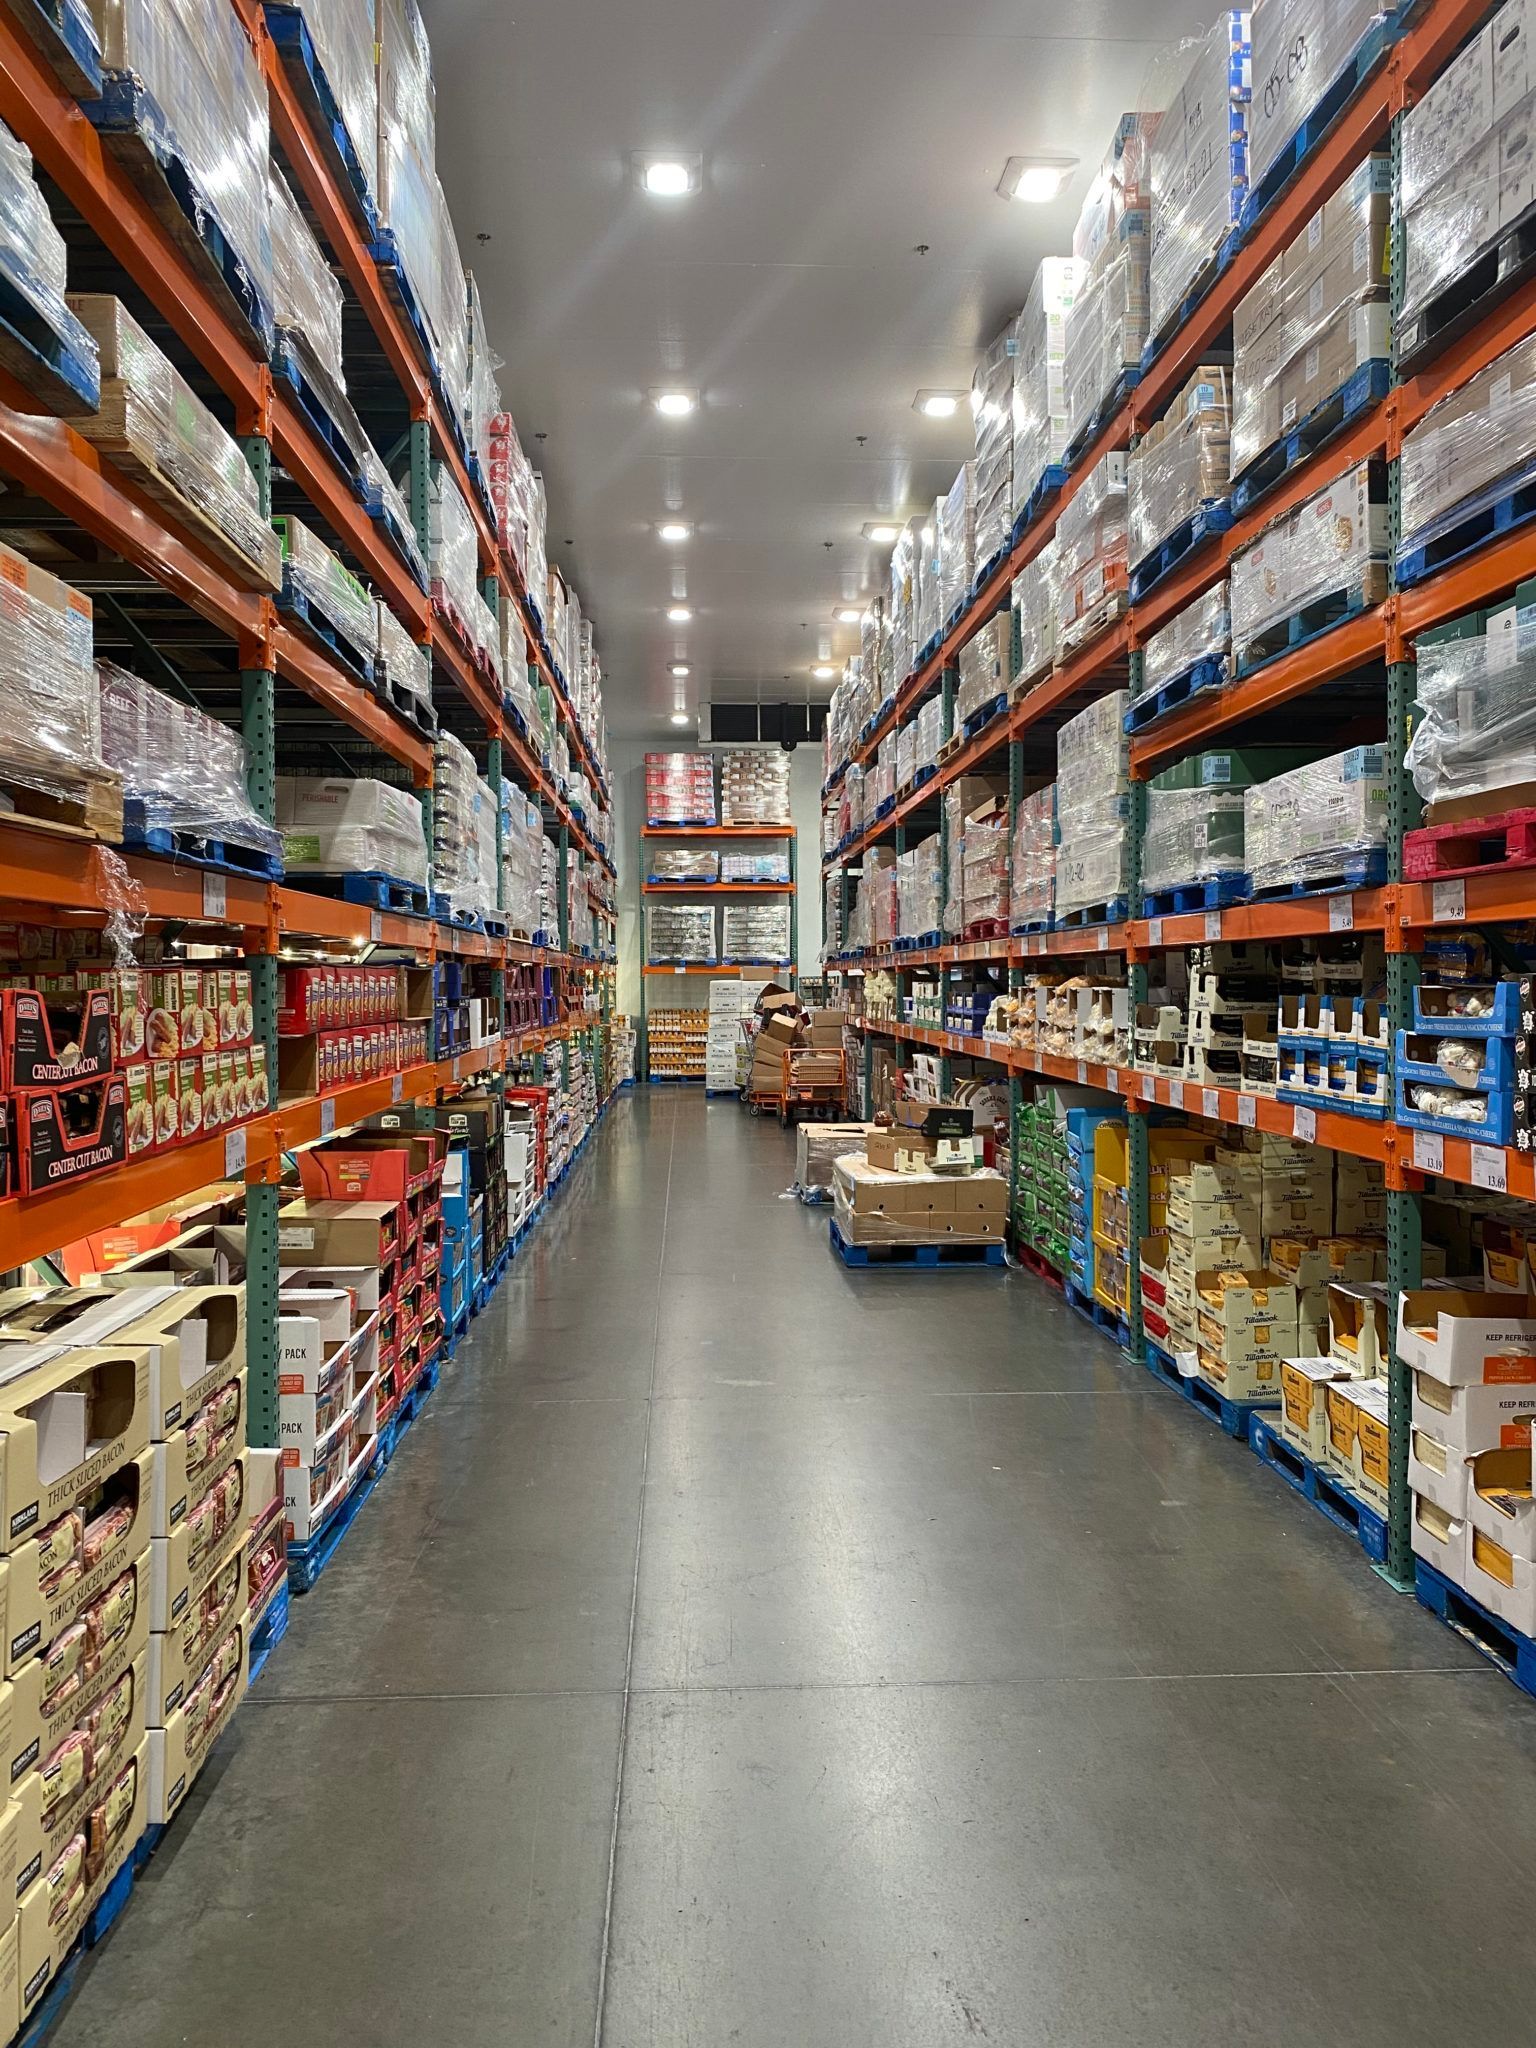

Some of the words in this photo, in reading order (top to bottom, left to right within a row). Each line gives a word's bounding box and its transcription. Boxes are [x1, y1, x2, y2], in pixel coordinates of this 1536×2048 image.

[1366, 748, 1376, 756] 113
[1450, 906, 1464, 918] 9.49
[32, 1064, 60, 1080] CENTER
[48, 1157, 76, 1178] CENTER
[76, 1153, 91, 1171] CUT
[91, 1145, 113, 1167] BACON
[1283, 1157, 1316, 1165] Tillamook
[1427, 1157, 1442, 1170] 13.19
[1487, 1175, 1505, 1190] 13.69
[1213, 1194, 1244, 1202] Tillamook
[1282, 1193, 1315, 1201] Tillamook
[1210, 1228, 1243, 1236] Tillamook
[1212, 1263, 1245, 1271] Tillamook
[1244, 1314, 1278, 1324] Tillamook
[285, 1348, 307, 1359] PACK
[1245, 1352, 1279, 1361] Tillamook
[1247, 1389, 1282, 1397] Tillamook
[281, 1423, 303, 1434] PACK
[48, 1480, 75, 1509] THICK
[75, 1459, 101, 1488] SLICED
[102, 1438, 126, 1468] BACON
[12, 1505, 38, 1531] KIRKLAND
[49, 1597, 75, 1627] THICK
[76, 1569, 103, 1600] SLICED
[104, 1544, 128, 1578] BACON
[12, 1625, 41, 1652] KIRKLAND
[48, 1709, 75, 1740] THICK
[75, 1674, 103, 1712] SLICED
[103, 1646, 128, 1687] BACON
[12, 1743, 40, 1773] KIRKLAND
[49, 1820, 75, 1853] THICK
[17, 1856, 42, 1888] KIRKLAND
[26, 1961, 50, 1996] KIRKLAND
